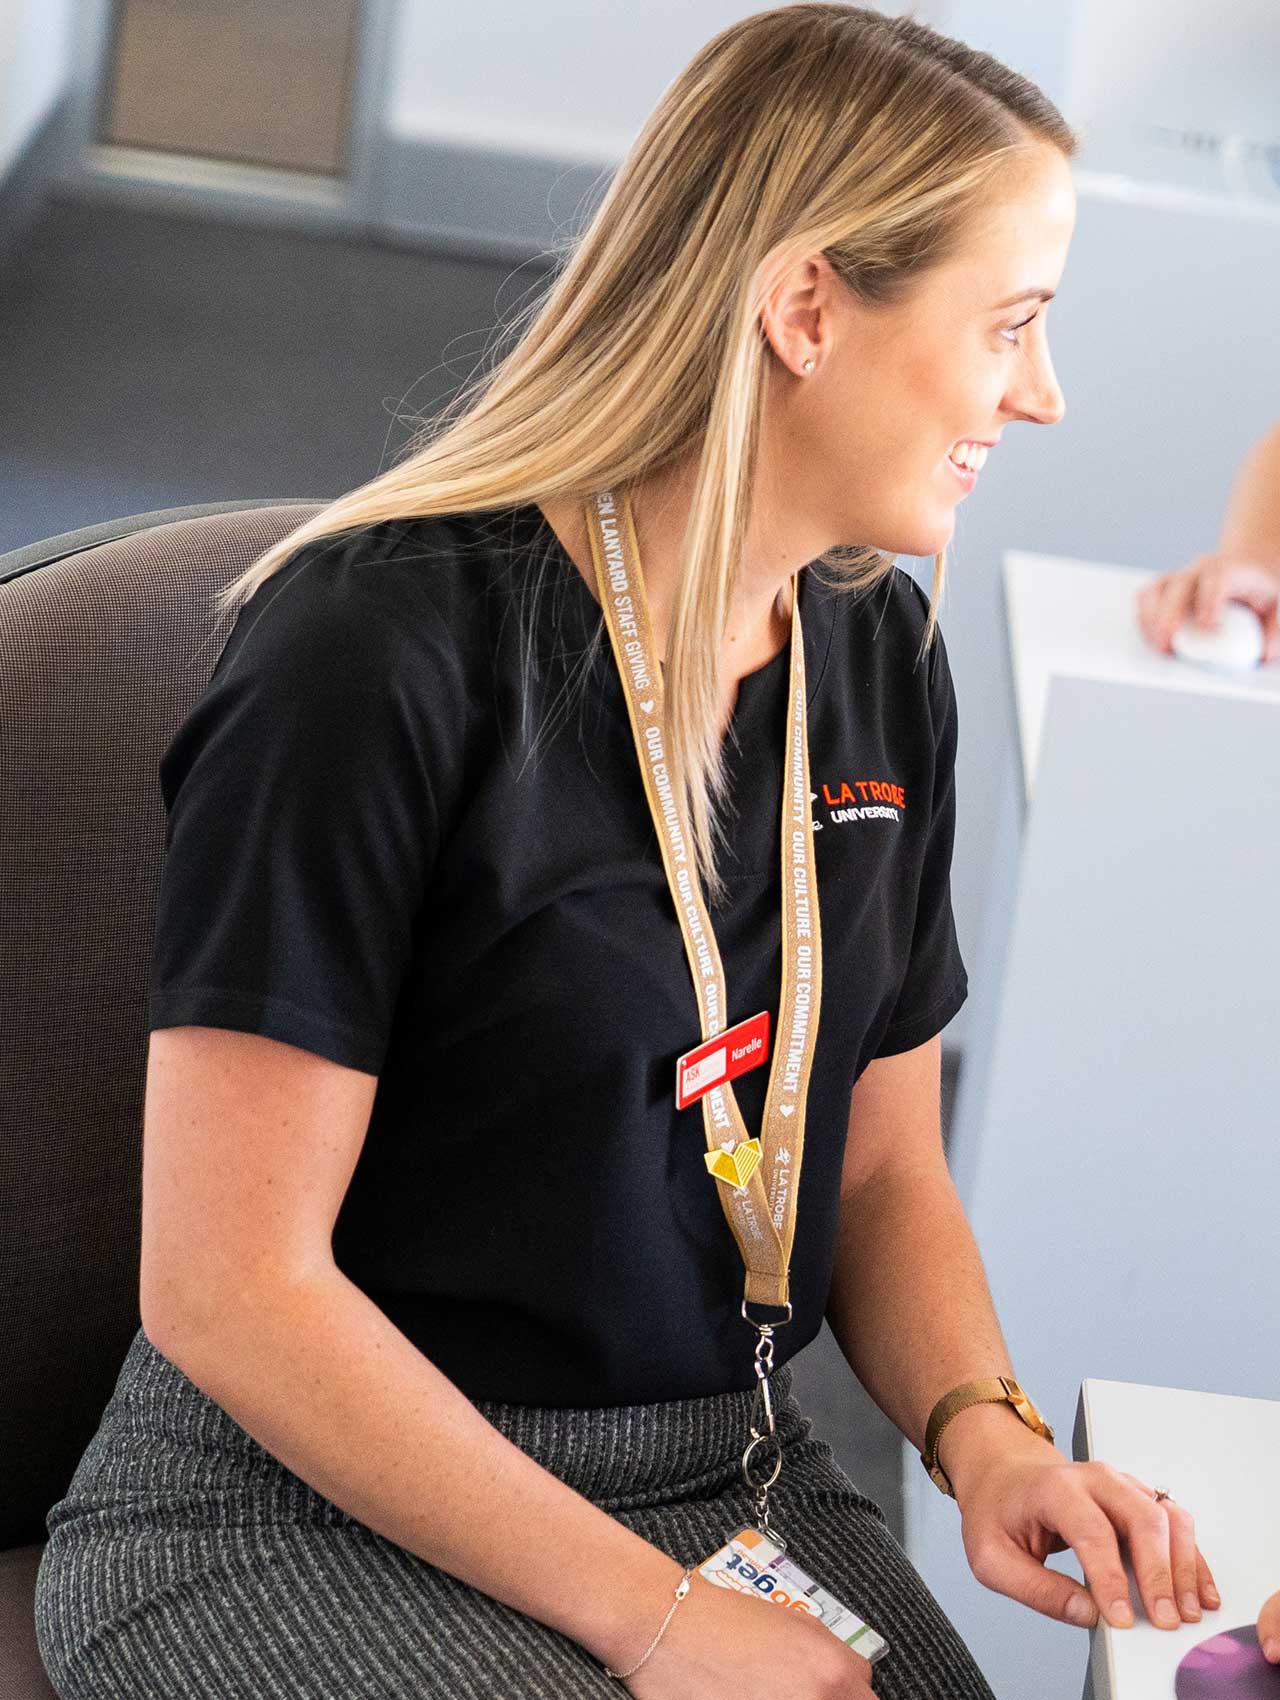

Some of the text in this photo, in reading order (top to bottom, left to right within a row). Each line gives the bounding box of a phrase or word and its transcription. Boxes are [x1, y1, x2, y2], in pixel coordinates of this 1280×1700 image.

[597, 492, 650, 690] EN LANYARD STAFF GIVING
[645, 726, 663, 762] OUR
[652, 763, 686, 862] COMMUNITY
[822, 780, 906, 809] LA TROBE
[830, 806, 899, 823] UNIVERSITY
[676, 869, 693, 903] OUR
[782, 688, 812, 1093] OUR COMMUNITY OUR CULTURE OUR COMMITMENT
[686, 905, 714, 978] CULTURE
[705, 983, 718, 1018] OUR
[731, 1038, 762, 1062] Narelle
[773, 1169, 790, 1230] LA TROBE
